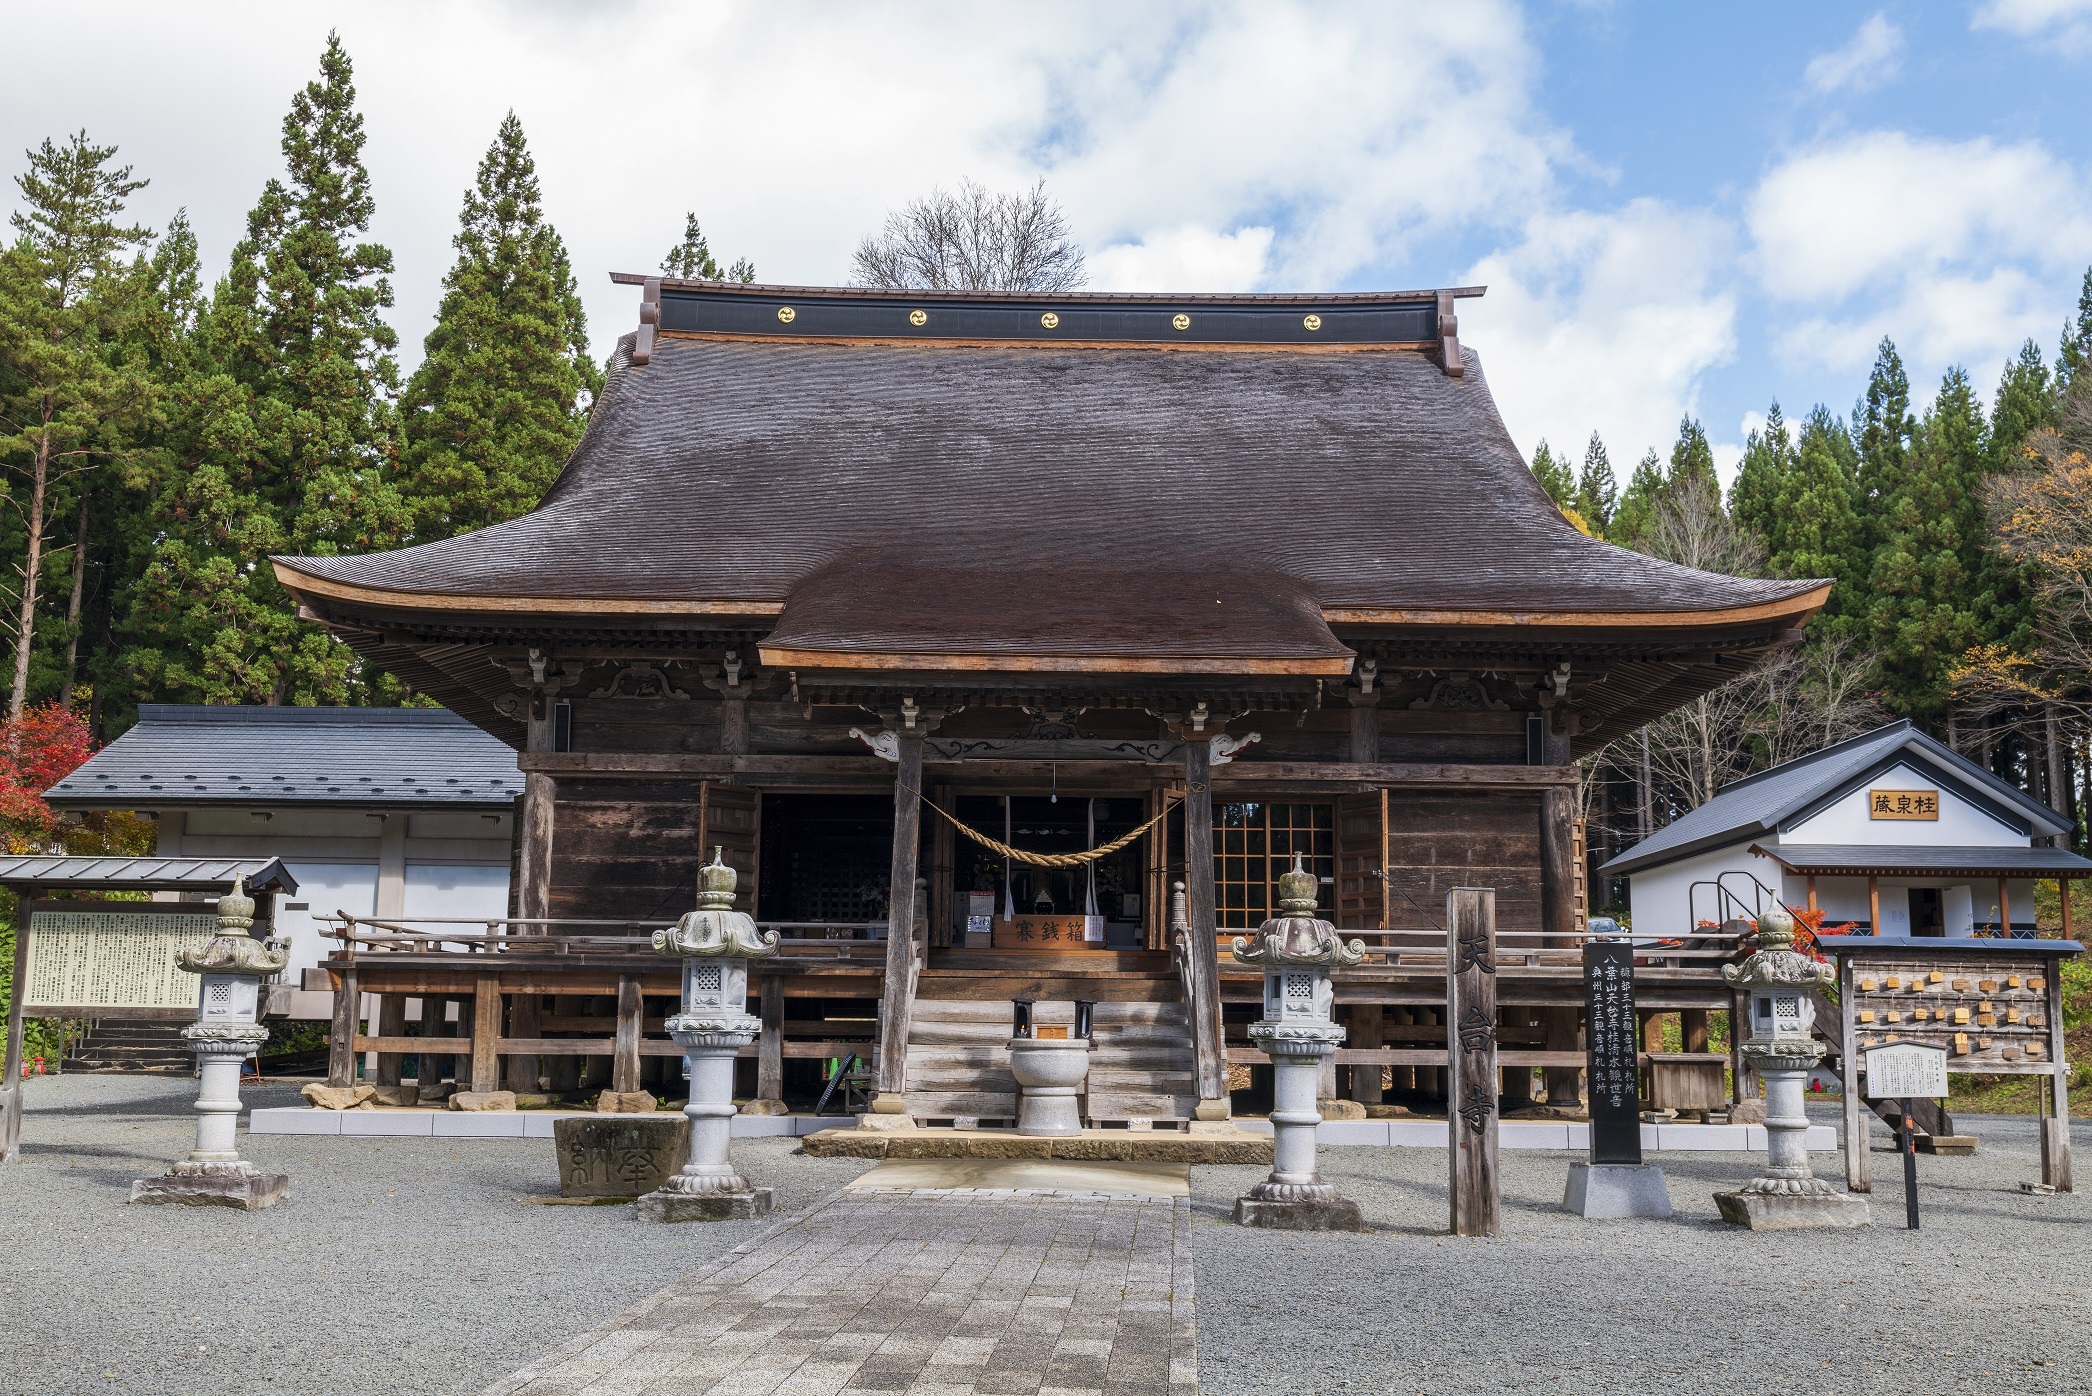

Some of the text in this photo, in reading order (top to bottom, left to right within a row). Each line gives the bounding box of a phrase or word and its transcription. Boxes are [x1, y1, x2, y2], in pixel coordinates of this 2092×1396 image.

[1015, 919, 1083, 942] 賽銭箱
[1453, 935, 1496, 1136] 天台寺
